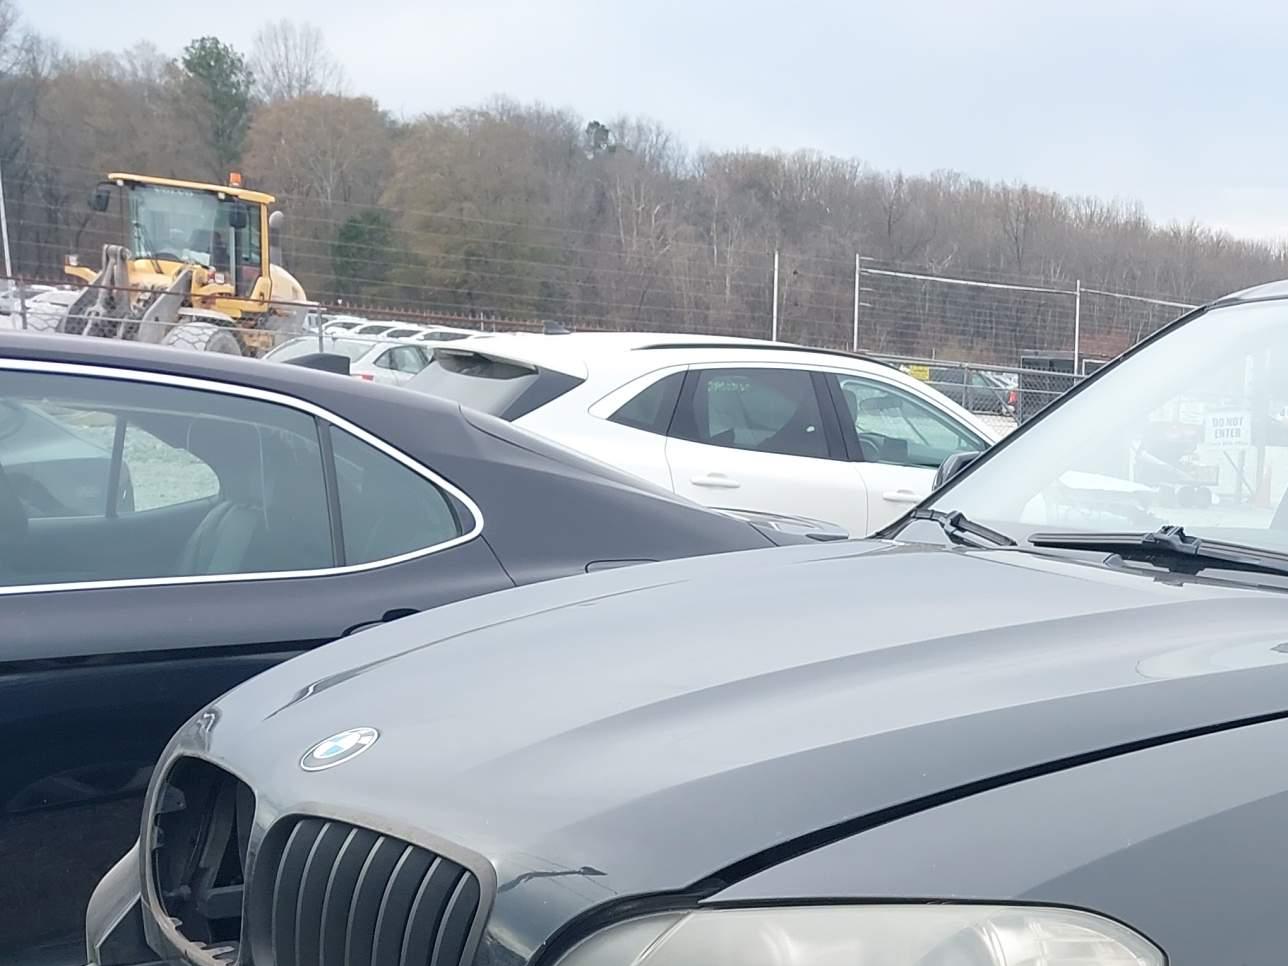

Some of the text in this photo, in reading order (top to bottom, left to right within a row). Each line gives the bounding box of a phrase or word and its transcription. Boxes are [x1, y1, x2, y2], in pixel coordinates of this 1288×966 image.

[1212, 416, 1243, 427] DO NOT
[1215, 428, 1241, 439] ENTER
